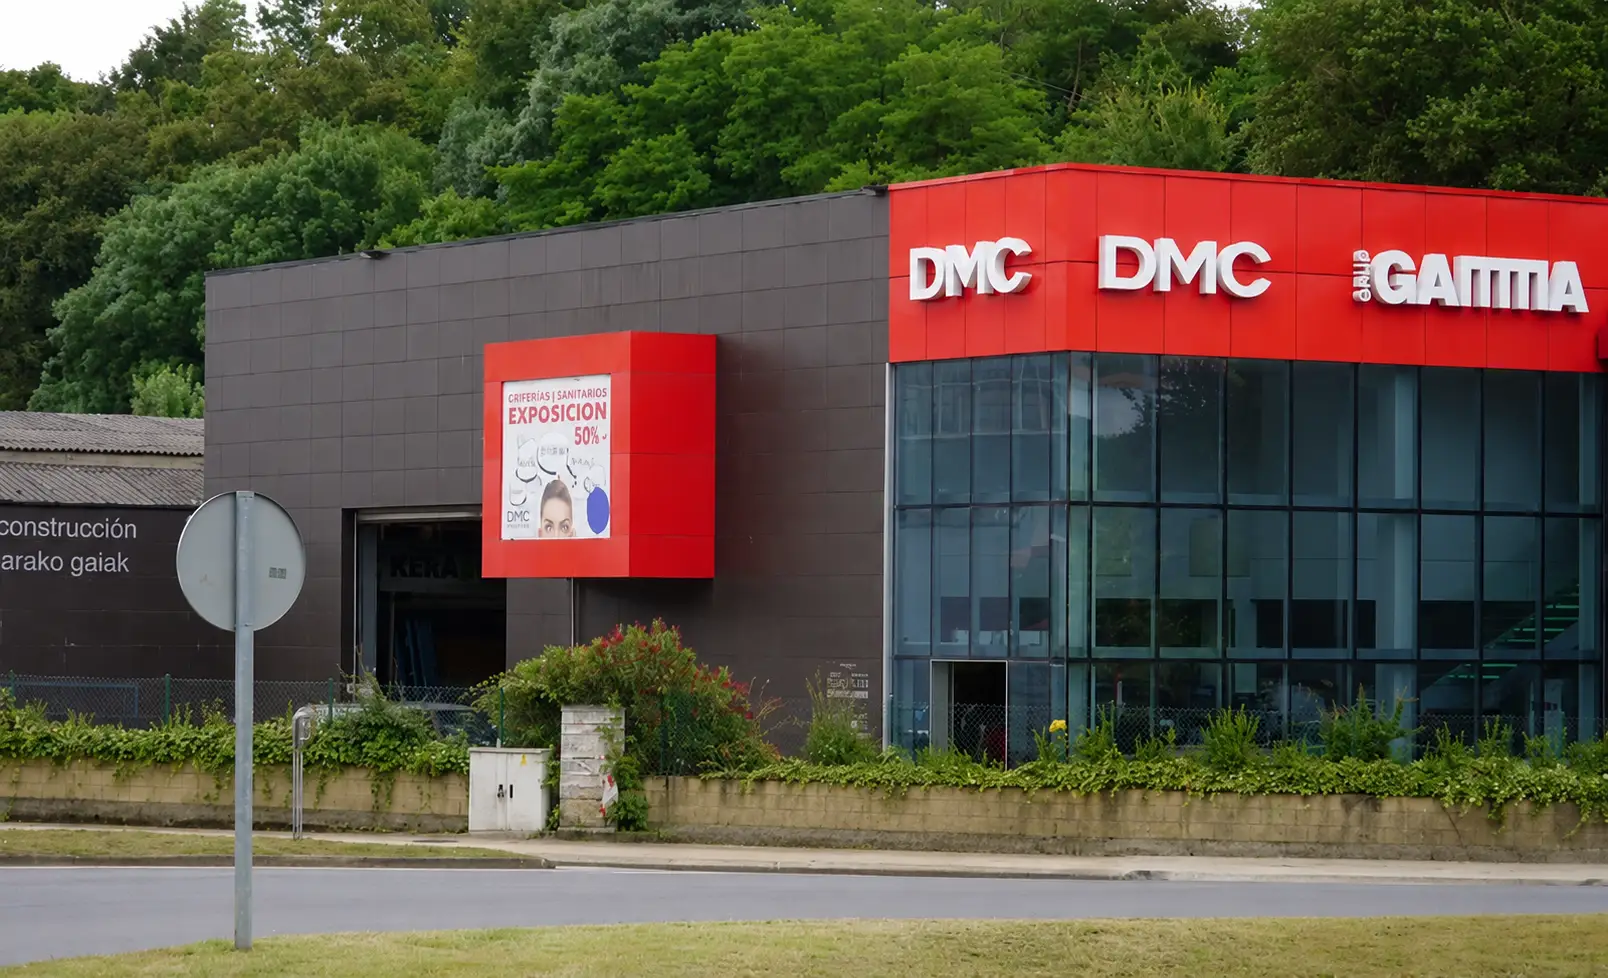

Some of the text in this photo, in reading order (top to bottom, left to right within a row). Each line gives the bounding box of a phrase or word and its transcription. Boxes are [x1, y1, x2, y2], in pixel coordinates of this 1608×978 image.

[909, 237, 1032, 301] DMC
[1098, 234, 1272, 298] DMC
[1370, 249, 1590, 313] GAMMA
[557, 387, 607, 400] SANITARIOS
[508, 401, 607, 425] EXPOSICION
[574, 425, 600, 446] 50%
[507, 510, 530, 522] DMC
[0, 518, 137, 539] construcción
[70, 551, 129, 577] gaiak
